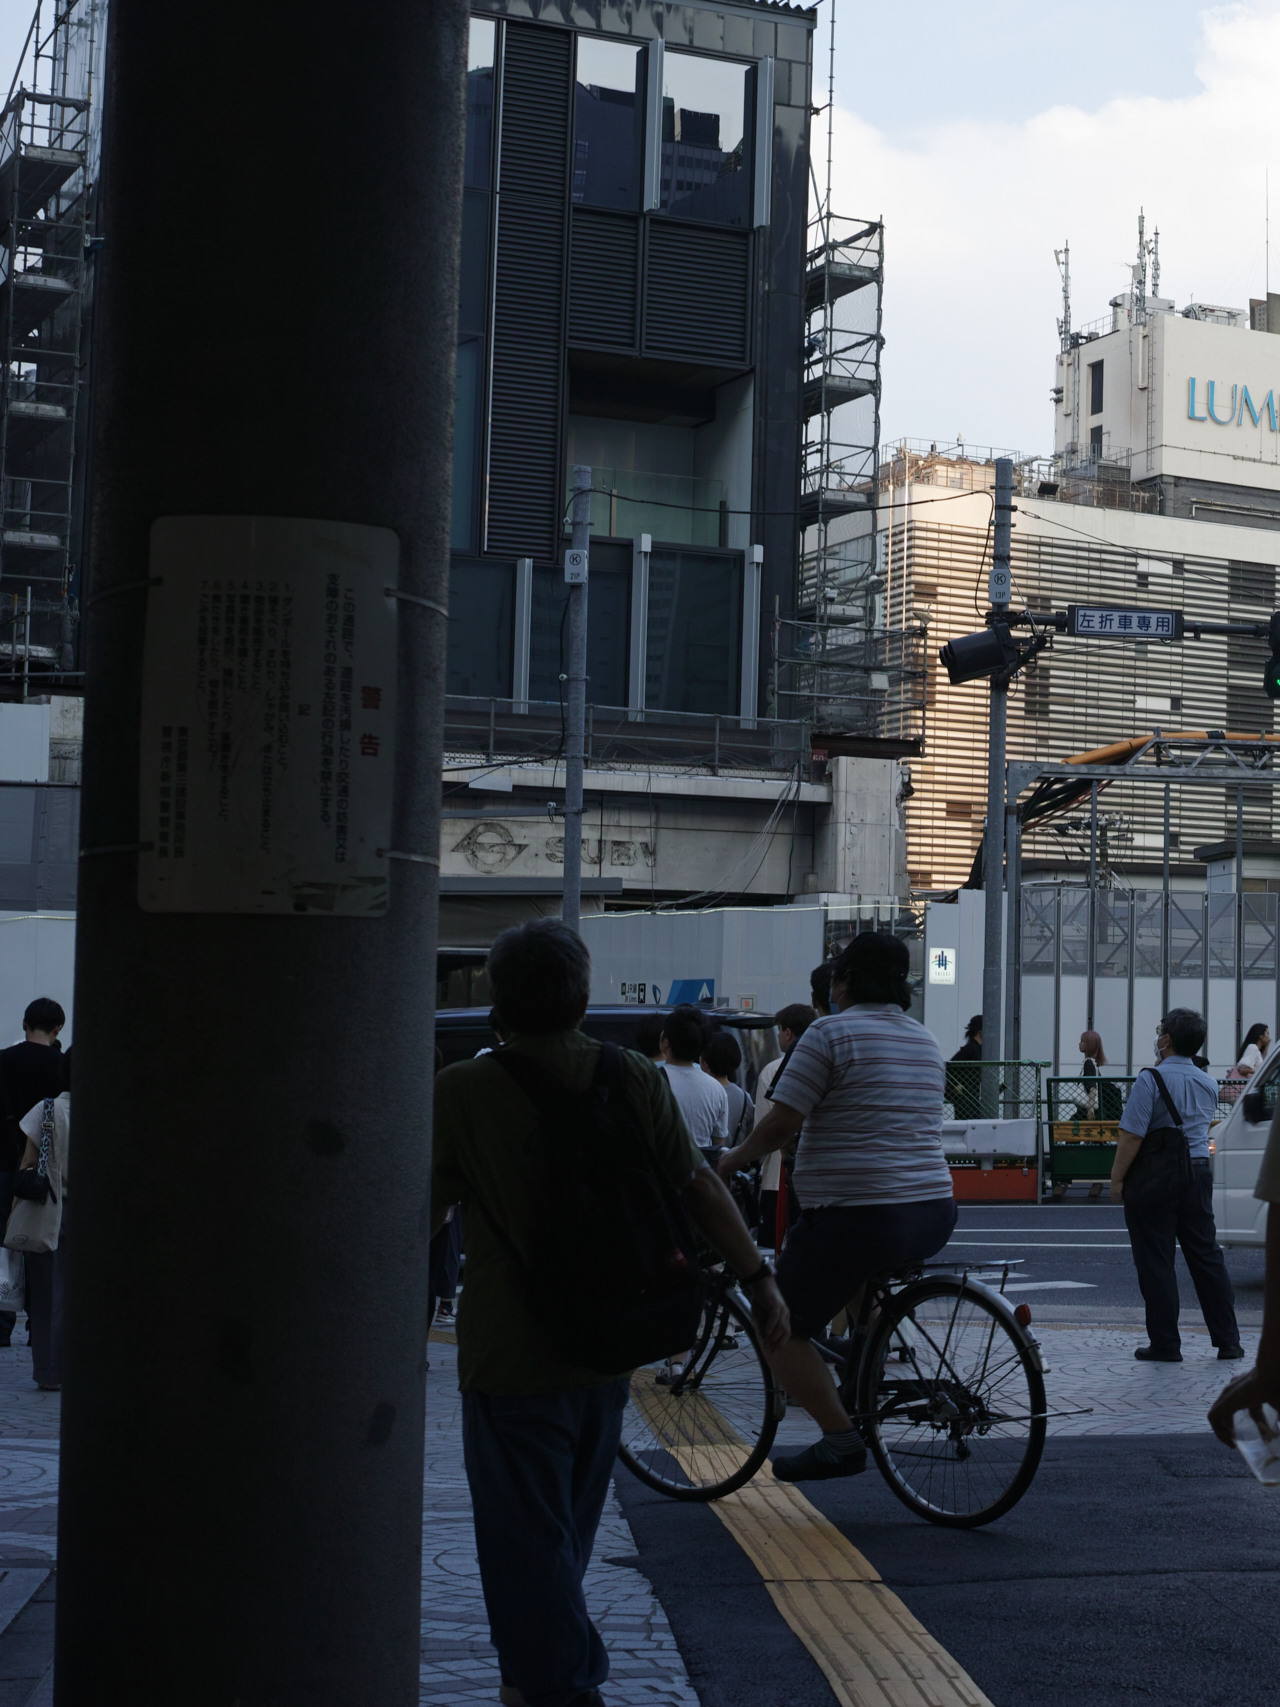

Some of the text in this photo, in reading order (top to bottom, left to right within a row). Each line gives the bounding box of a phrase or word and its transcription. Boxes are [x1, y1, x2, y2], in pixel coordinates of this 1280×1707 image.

[1079, 609, 1174, 636] 左折車専用
